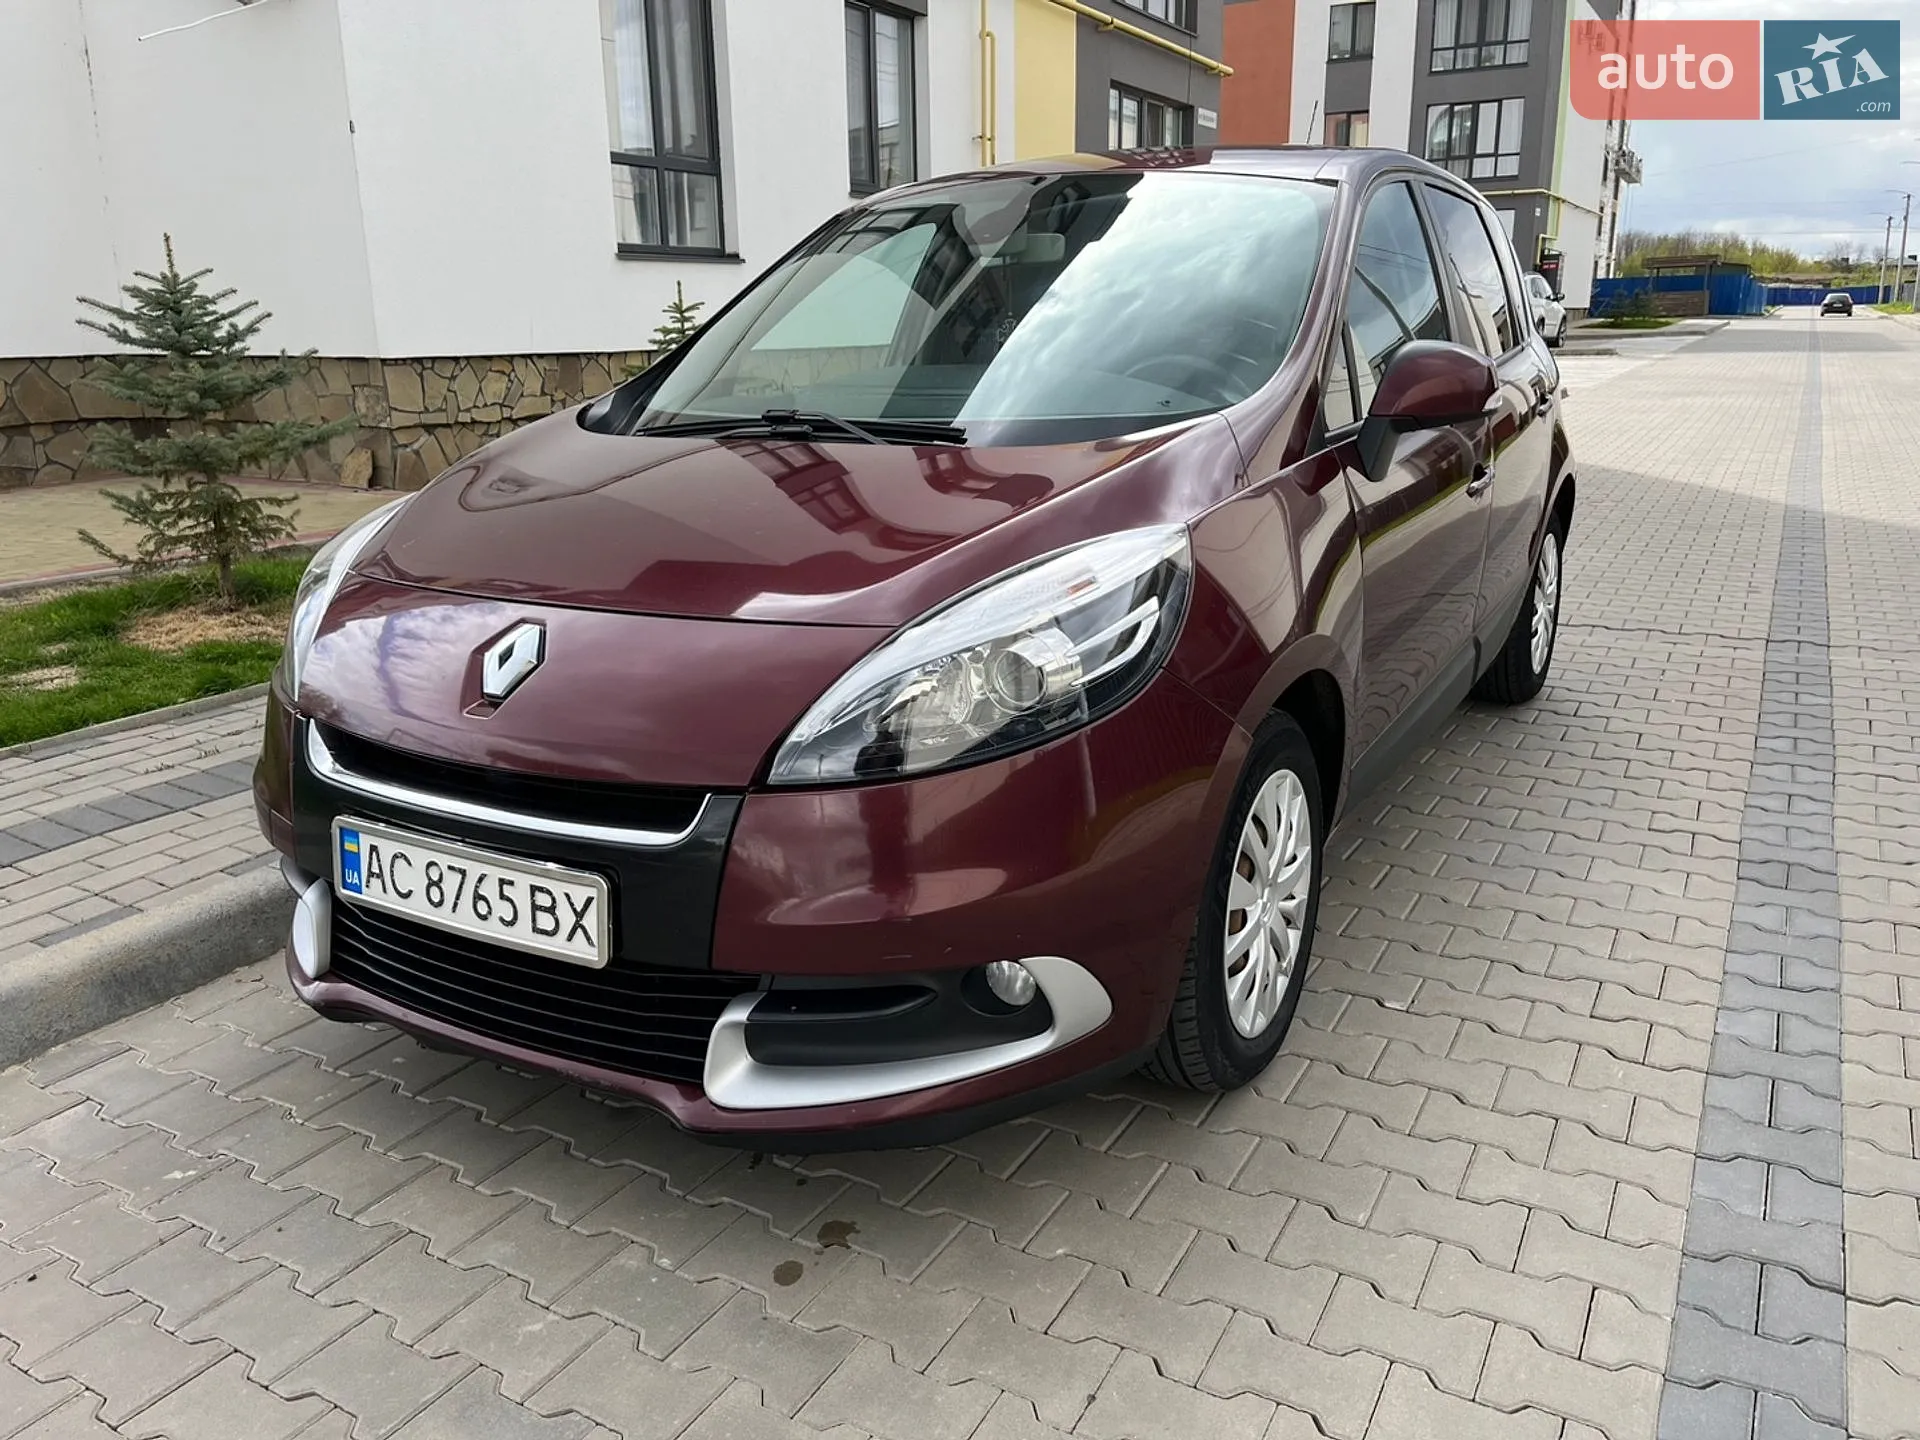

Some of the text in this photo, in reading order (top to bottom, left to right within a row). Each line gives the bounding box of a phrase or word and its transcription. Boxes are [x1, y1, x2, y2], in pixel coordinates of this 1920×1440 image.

[345, 868, 360, 886] UA
[365, 844, 596, 948] AC 8765 BX
